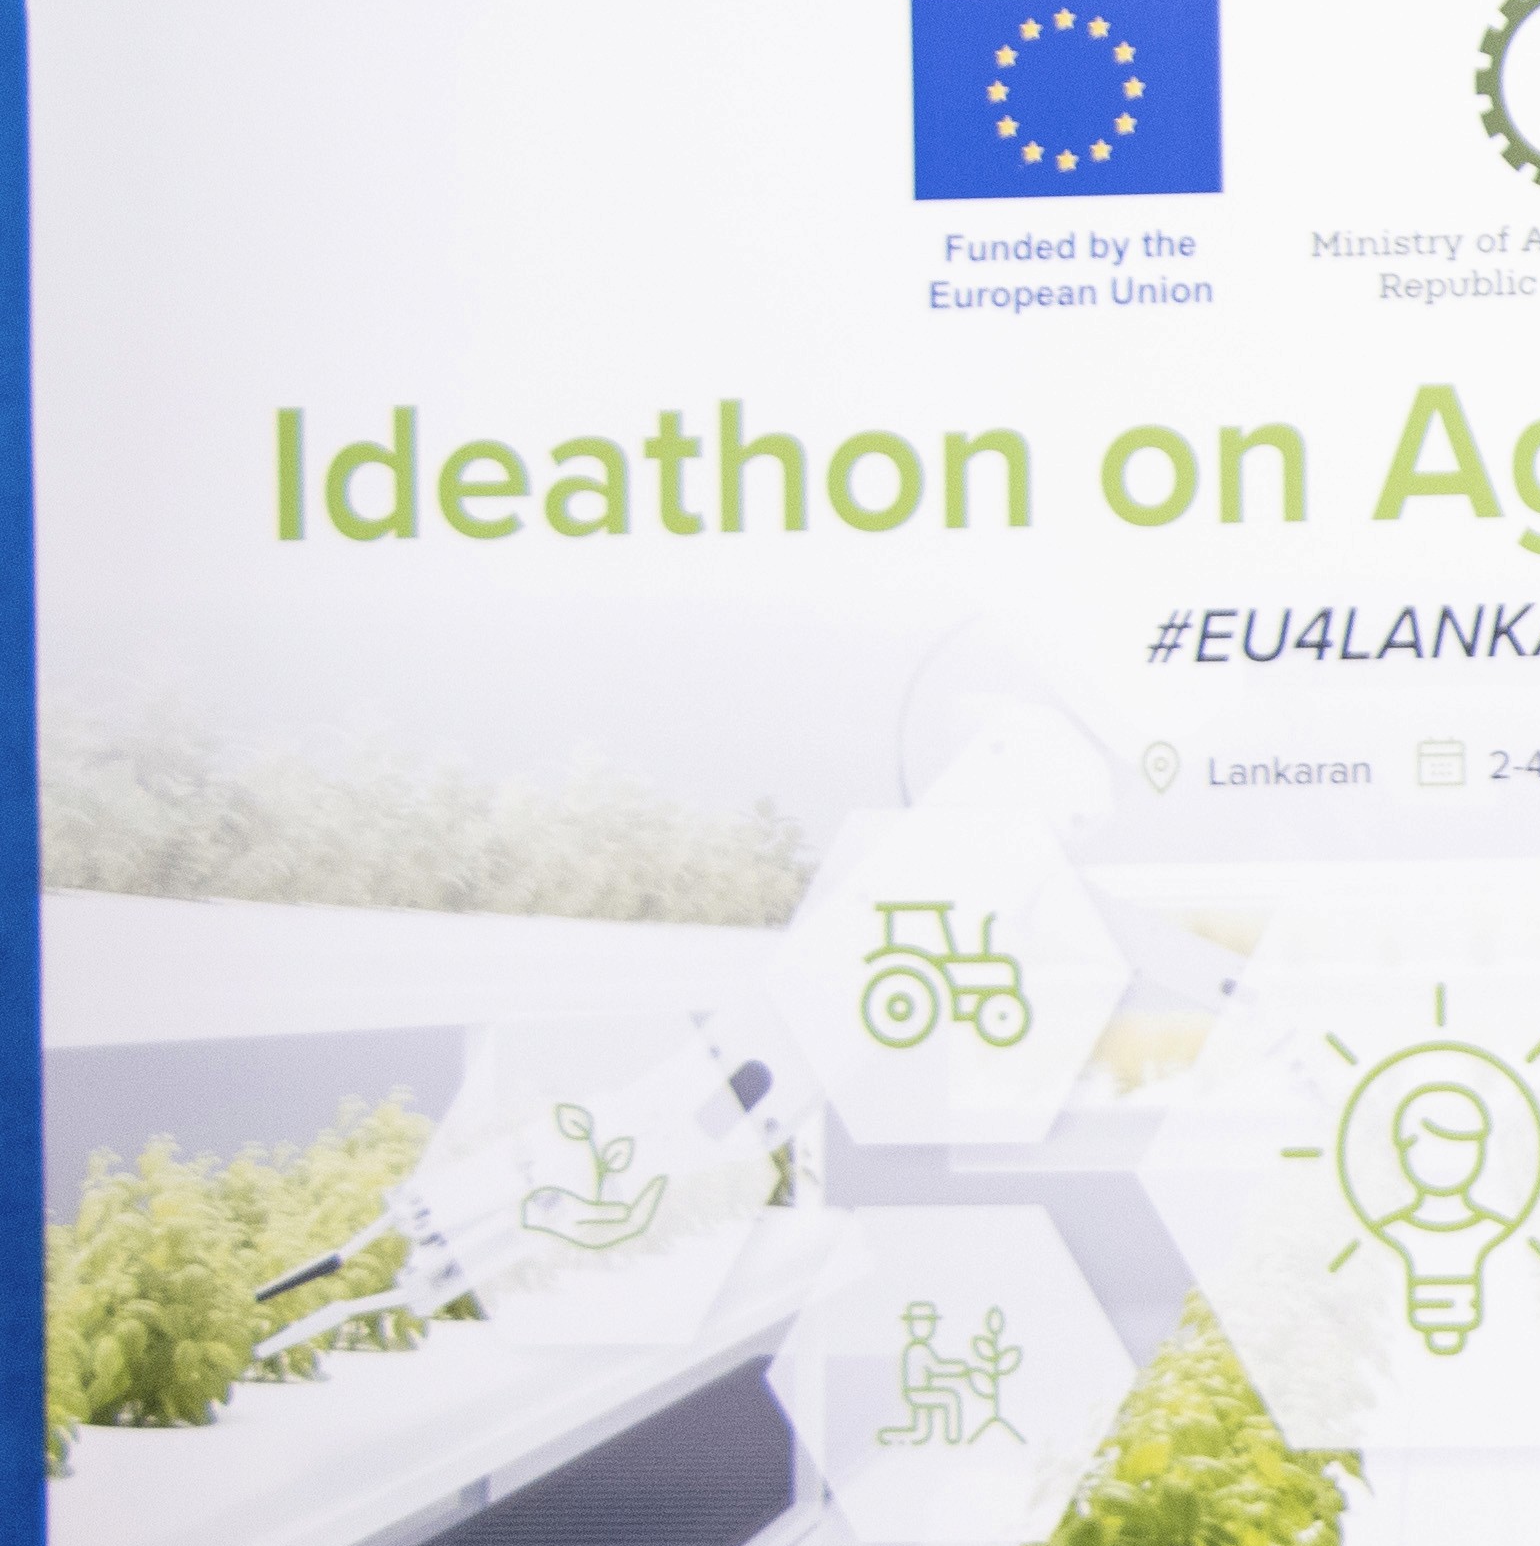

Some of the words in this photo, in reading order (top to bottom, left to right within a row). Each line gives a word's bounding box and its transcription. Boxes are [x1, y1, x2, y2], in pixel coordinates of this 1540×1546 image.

[942, 231, 1079, 265] Funded
[1086, 231, 1131, 269] by
[1139, 229, 1198, 260] the
[1309, 229, 1465, 265] Ministry
[1473, 224, 1511, 256] of
[926, 278, 1099, 318] European
[1107, 275, 1216, 309] Union
[1376, 268, 1539, 309] Republic
[273, 398, 1030, 544] Ideathon
[1098, 422, 1307, 530] on
[1205, 755, 1374, 791] Lankaran
